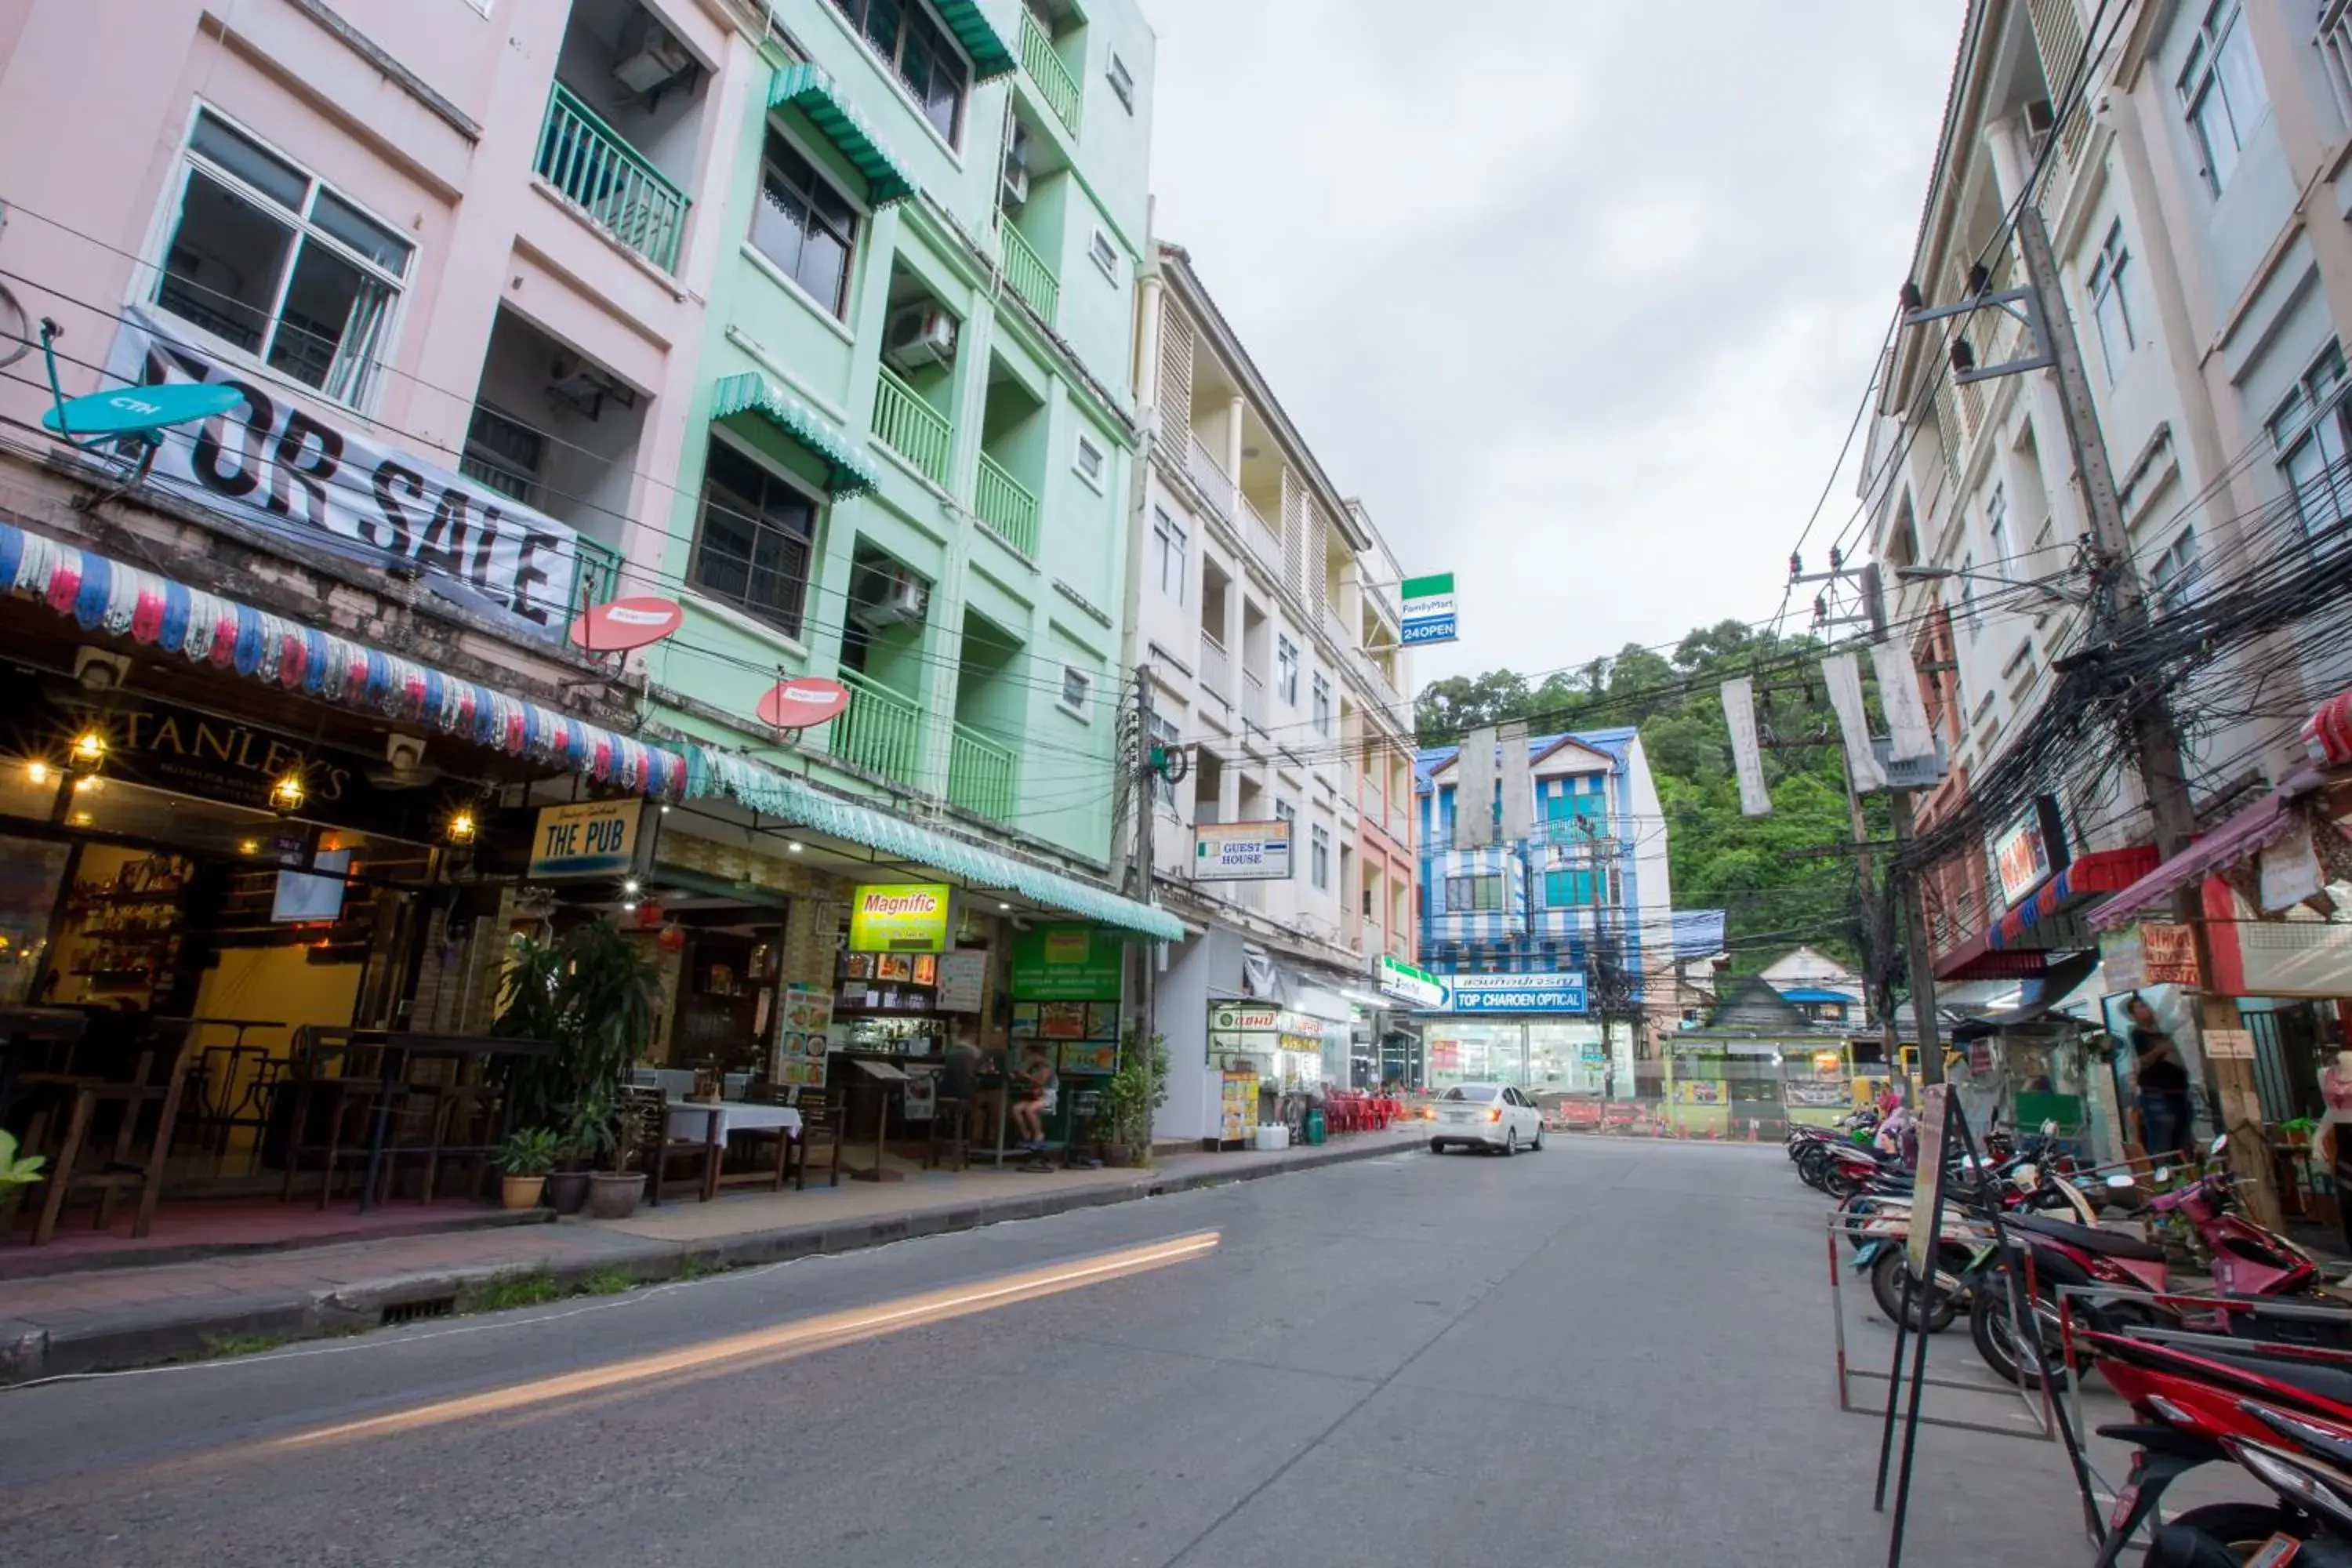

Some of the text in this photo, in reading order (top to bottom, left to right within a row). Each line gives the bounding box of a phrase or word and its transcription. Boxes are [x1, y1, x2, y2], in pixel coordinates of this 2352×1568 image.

[358, 459, 558, 627] SALE
[96, 708, 350, 800] TANLEY'S
[546, 818, 625, 857] THE PUB
[1224, 842, 1261, 854] GUEST
[1221, 853, 1262, 865] HOUSE
[864, 892, 935, 915] Magnific
[1458, 993, 1481, 1007] TOP
[1483, 993, 1536, 1007] CHAROEN
[1537, 993, 1580, 1007] OPTICAL
